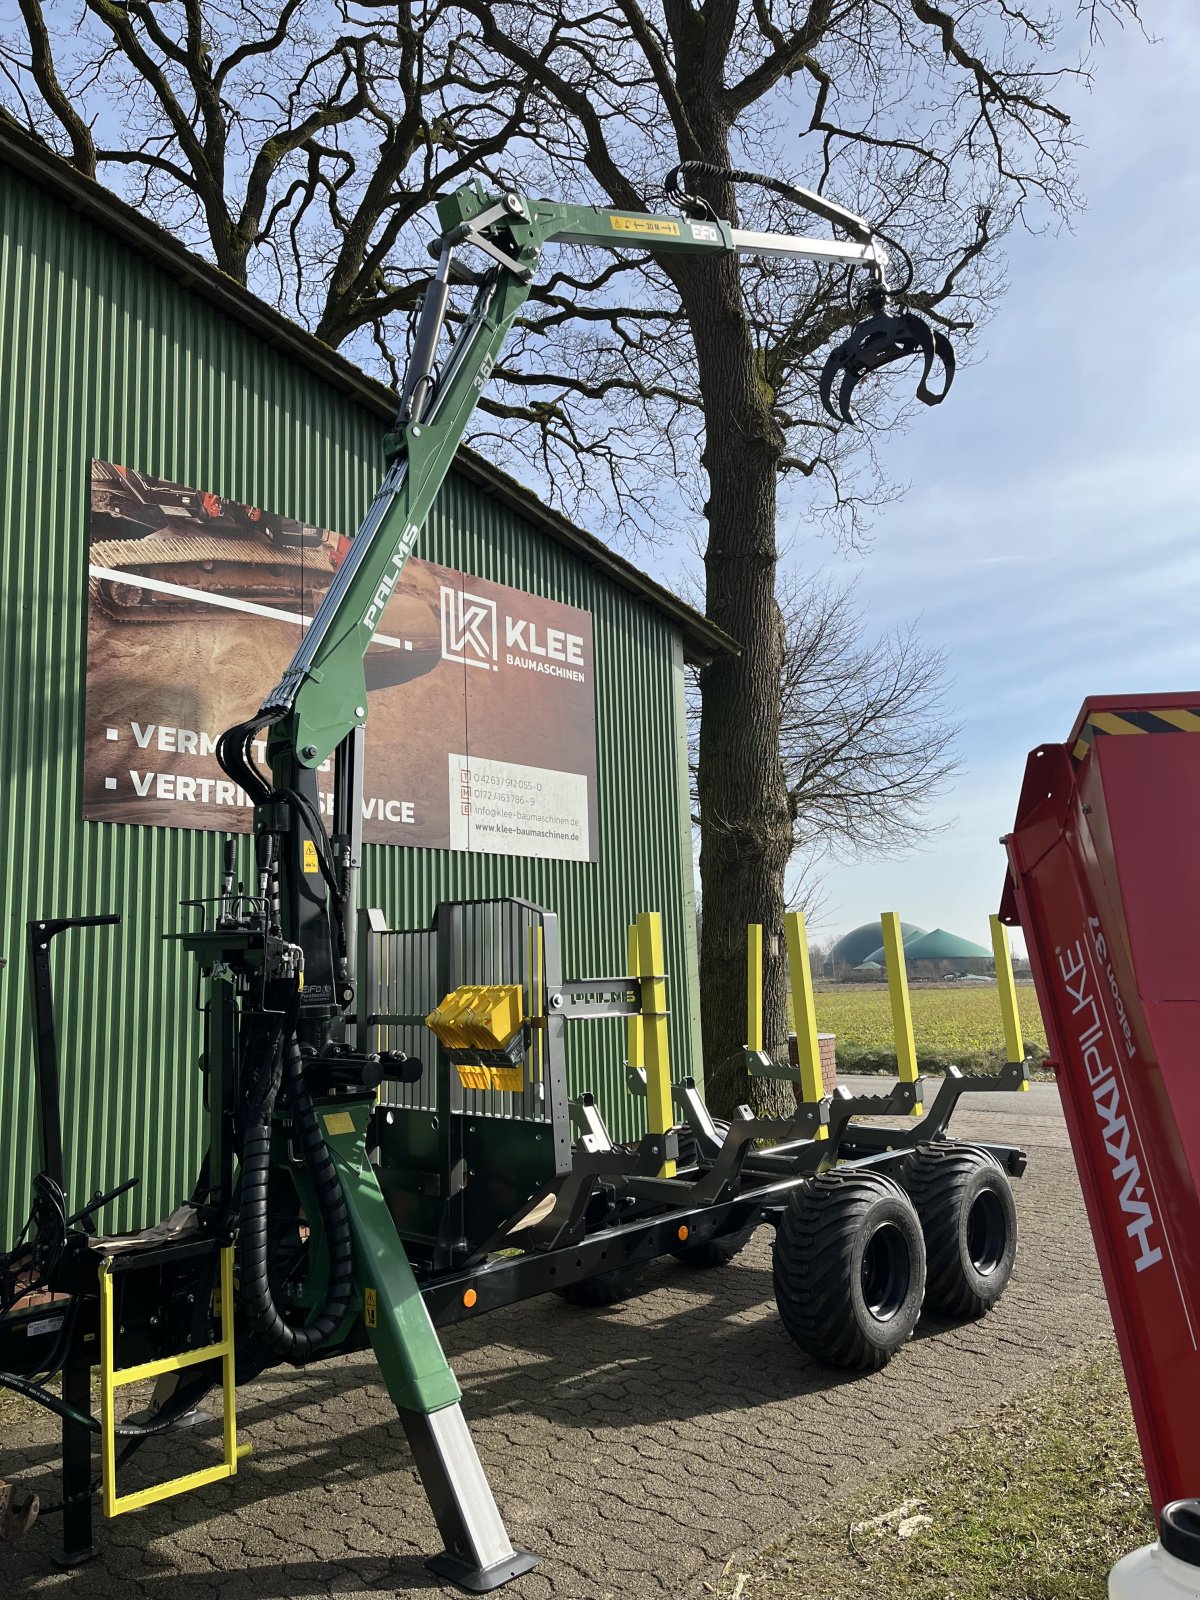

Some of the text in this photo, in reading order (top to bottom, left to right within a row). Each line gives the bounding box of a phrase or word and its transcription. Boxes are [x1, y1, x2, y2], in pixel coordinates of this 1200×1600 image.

[363, 522, 418, 630] PALMS
[505, 615, 584, 666] KLEE
[506, 653, 585, 683] BAUMASCHINEN
[475, 806, 579, 827] info@klee-baumaschinen.de
[475, 822, 580, 841] www.klee-baumaschinen.de
[570, 989, 636, 1006] PALMS
[1105, 963, 1136, 1058] Falcon
